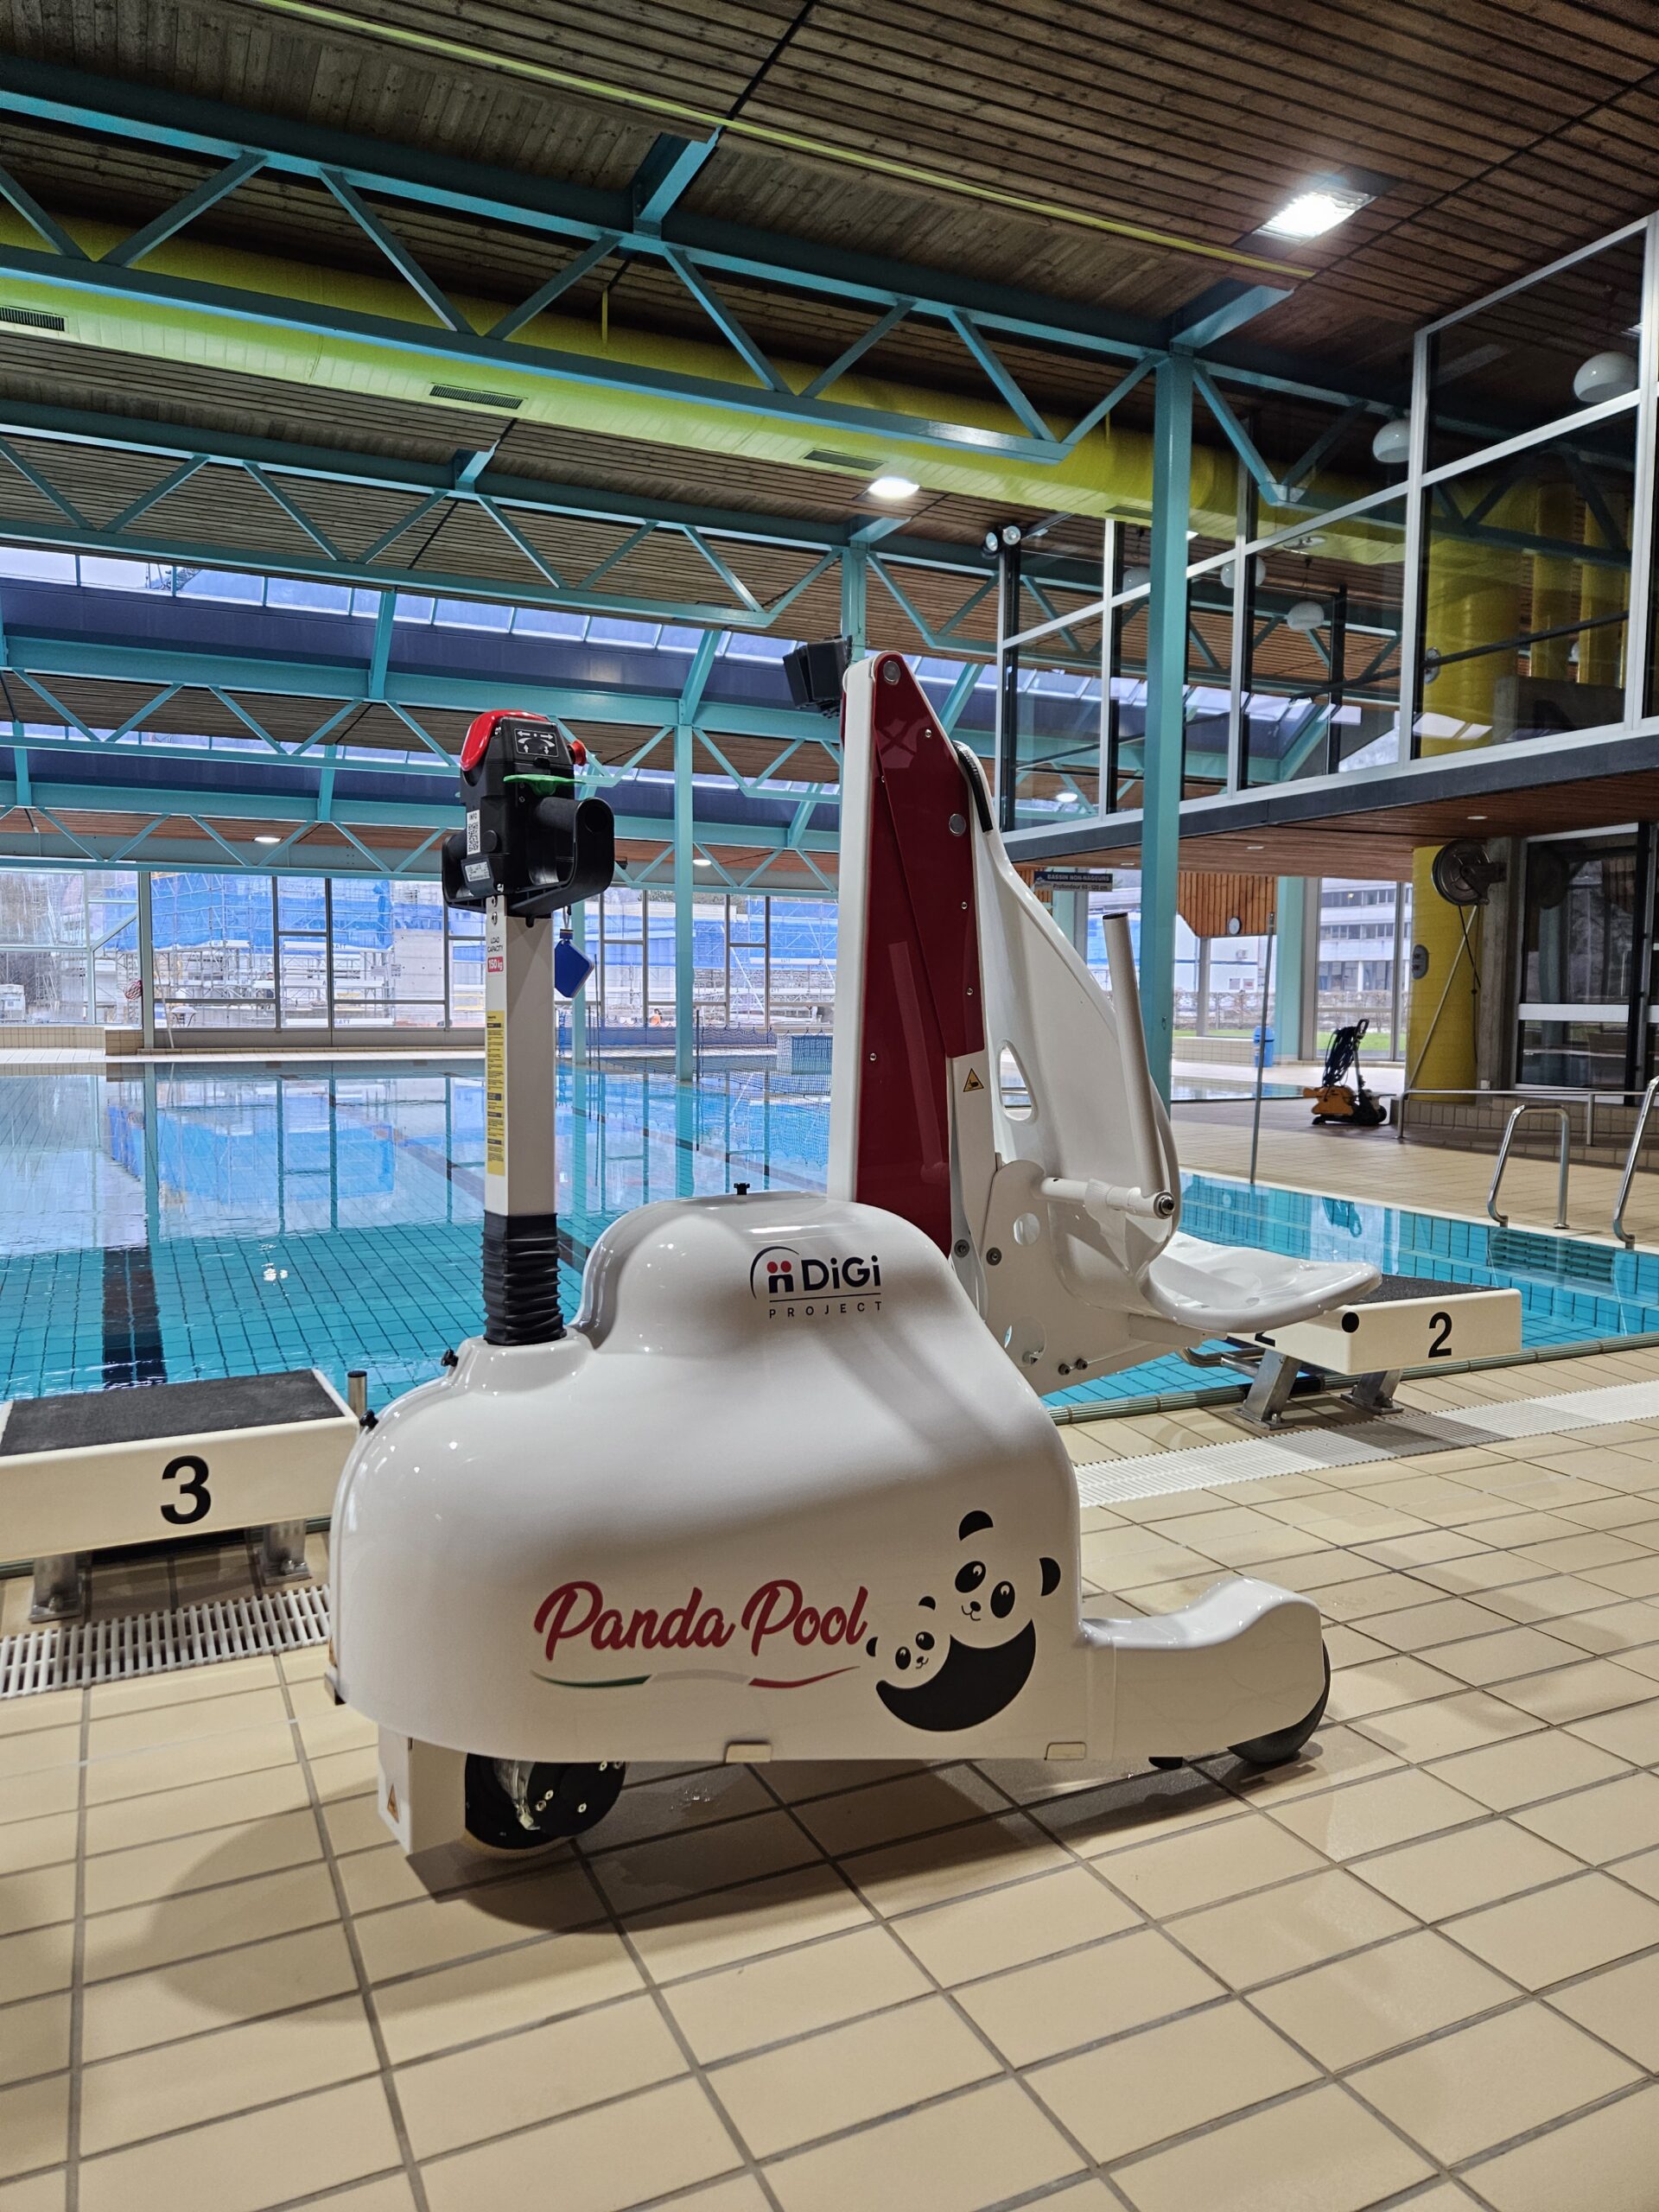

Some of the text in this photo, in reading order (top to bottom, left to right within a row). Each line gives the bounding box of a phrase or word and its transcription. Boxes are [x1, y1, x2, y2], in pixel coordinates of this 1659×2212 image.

[487, 944, 504, 953] CAPACITY
[490, 936, 500, 944] LOAD
[488, 958, 498, 969] 150
[769, 1301, 882, 1319] PROJECT
[1428, 1311, 1452, 1358] 2
[161, 1454, 212, 1525] 3
[533, 1579, 869, 1662] Panda Pool
